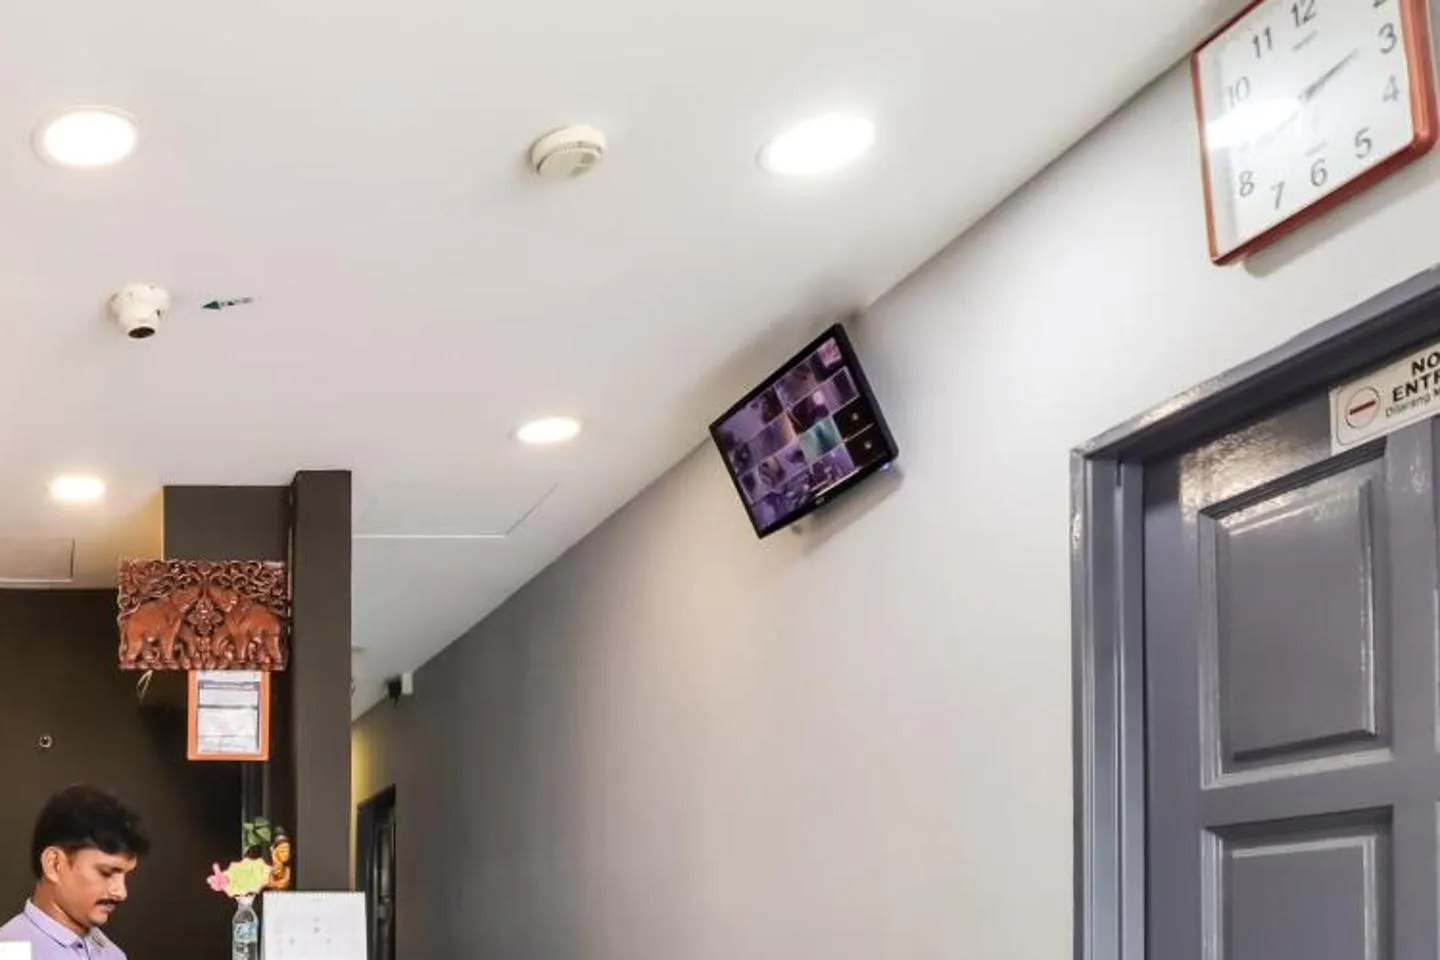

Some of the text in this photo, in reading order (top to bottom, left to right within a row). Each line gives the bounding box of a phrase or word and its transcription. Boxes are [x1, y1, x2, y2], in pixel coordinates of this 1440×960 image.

[1252, 26, 1273, 58] 11
[1378, 22, 1396, 54] 3
[1227, 76, 1250, 108] 10
[1383, 75, 1400, 103] 4
[1355, 127, 1371, 159] 5
[1239, 171, 1254, 198] 8
[1311, 158, 1328, 187] 6
[1270, 181, 1285, 209] 7
[1412, 351, 1440, 376] NO
